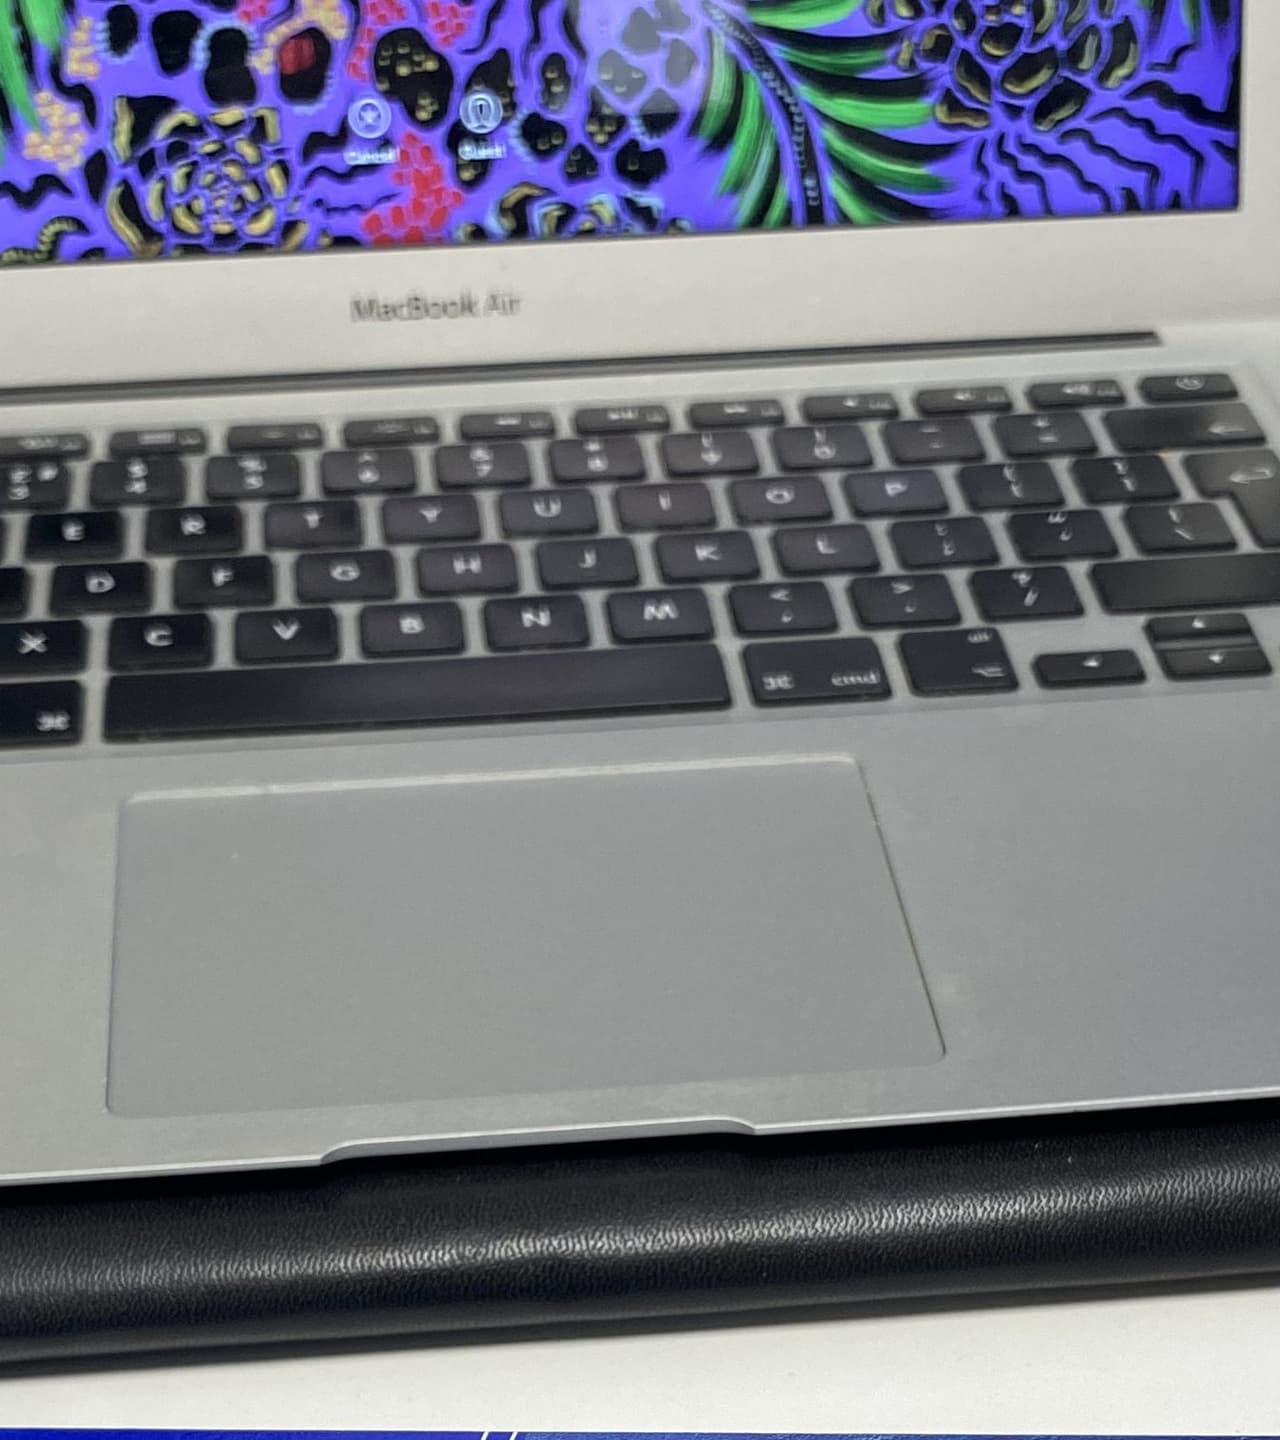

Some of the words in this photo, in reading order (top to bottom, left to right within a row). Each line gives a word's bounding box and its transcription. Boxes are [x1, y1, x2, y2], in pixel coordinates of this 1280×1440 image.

[351, 292, 477, 321] MacBook
[62, 519, 87, 543] E
[180, 513, 207, 536] R
[303, 507, 323, 528] T
[420, 504, 443, 524] Y
[533, 498, 562, 518] U
[765, 486, 796, 504] O
[884, 478, 909, 497] P
[521, 605, 552, 628] N
[644, 598, 679, 622] M
